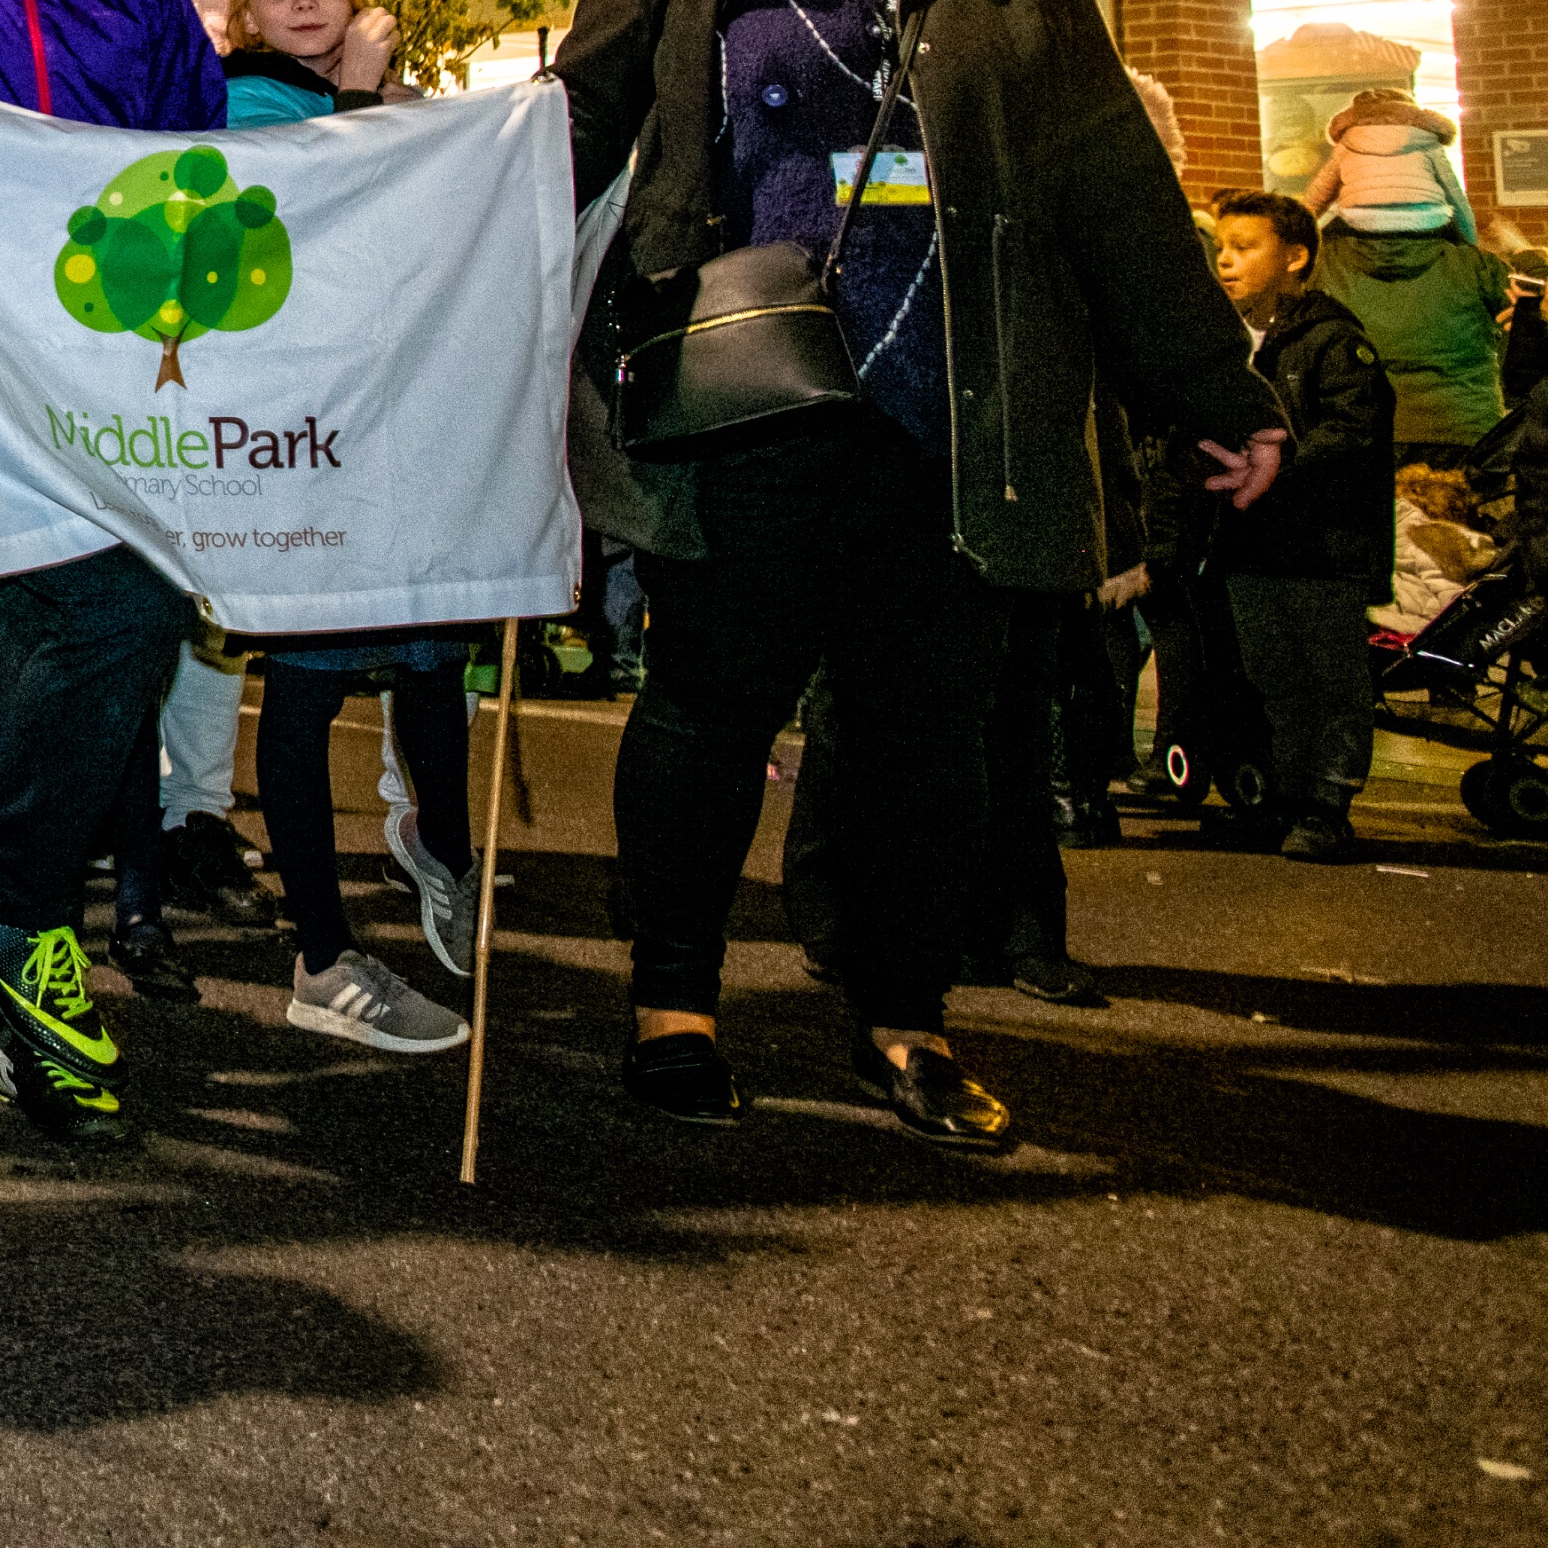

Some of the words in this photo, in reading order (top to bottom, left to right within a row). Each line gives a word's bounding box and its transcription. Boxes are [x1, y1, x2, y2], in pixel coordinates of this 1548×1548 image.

[185, 474, 263, 496] School
[192, 532, 247, 551] grow
[253, 527, 347, 552] together
